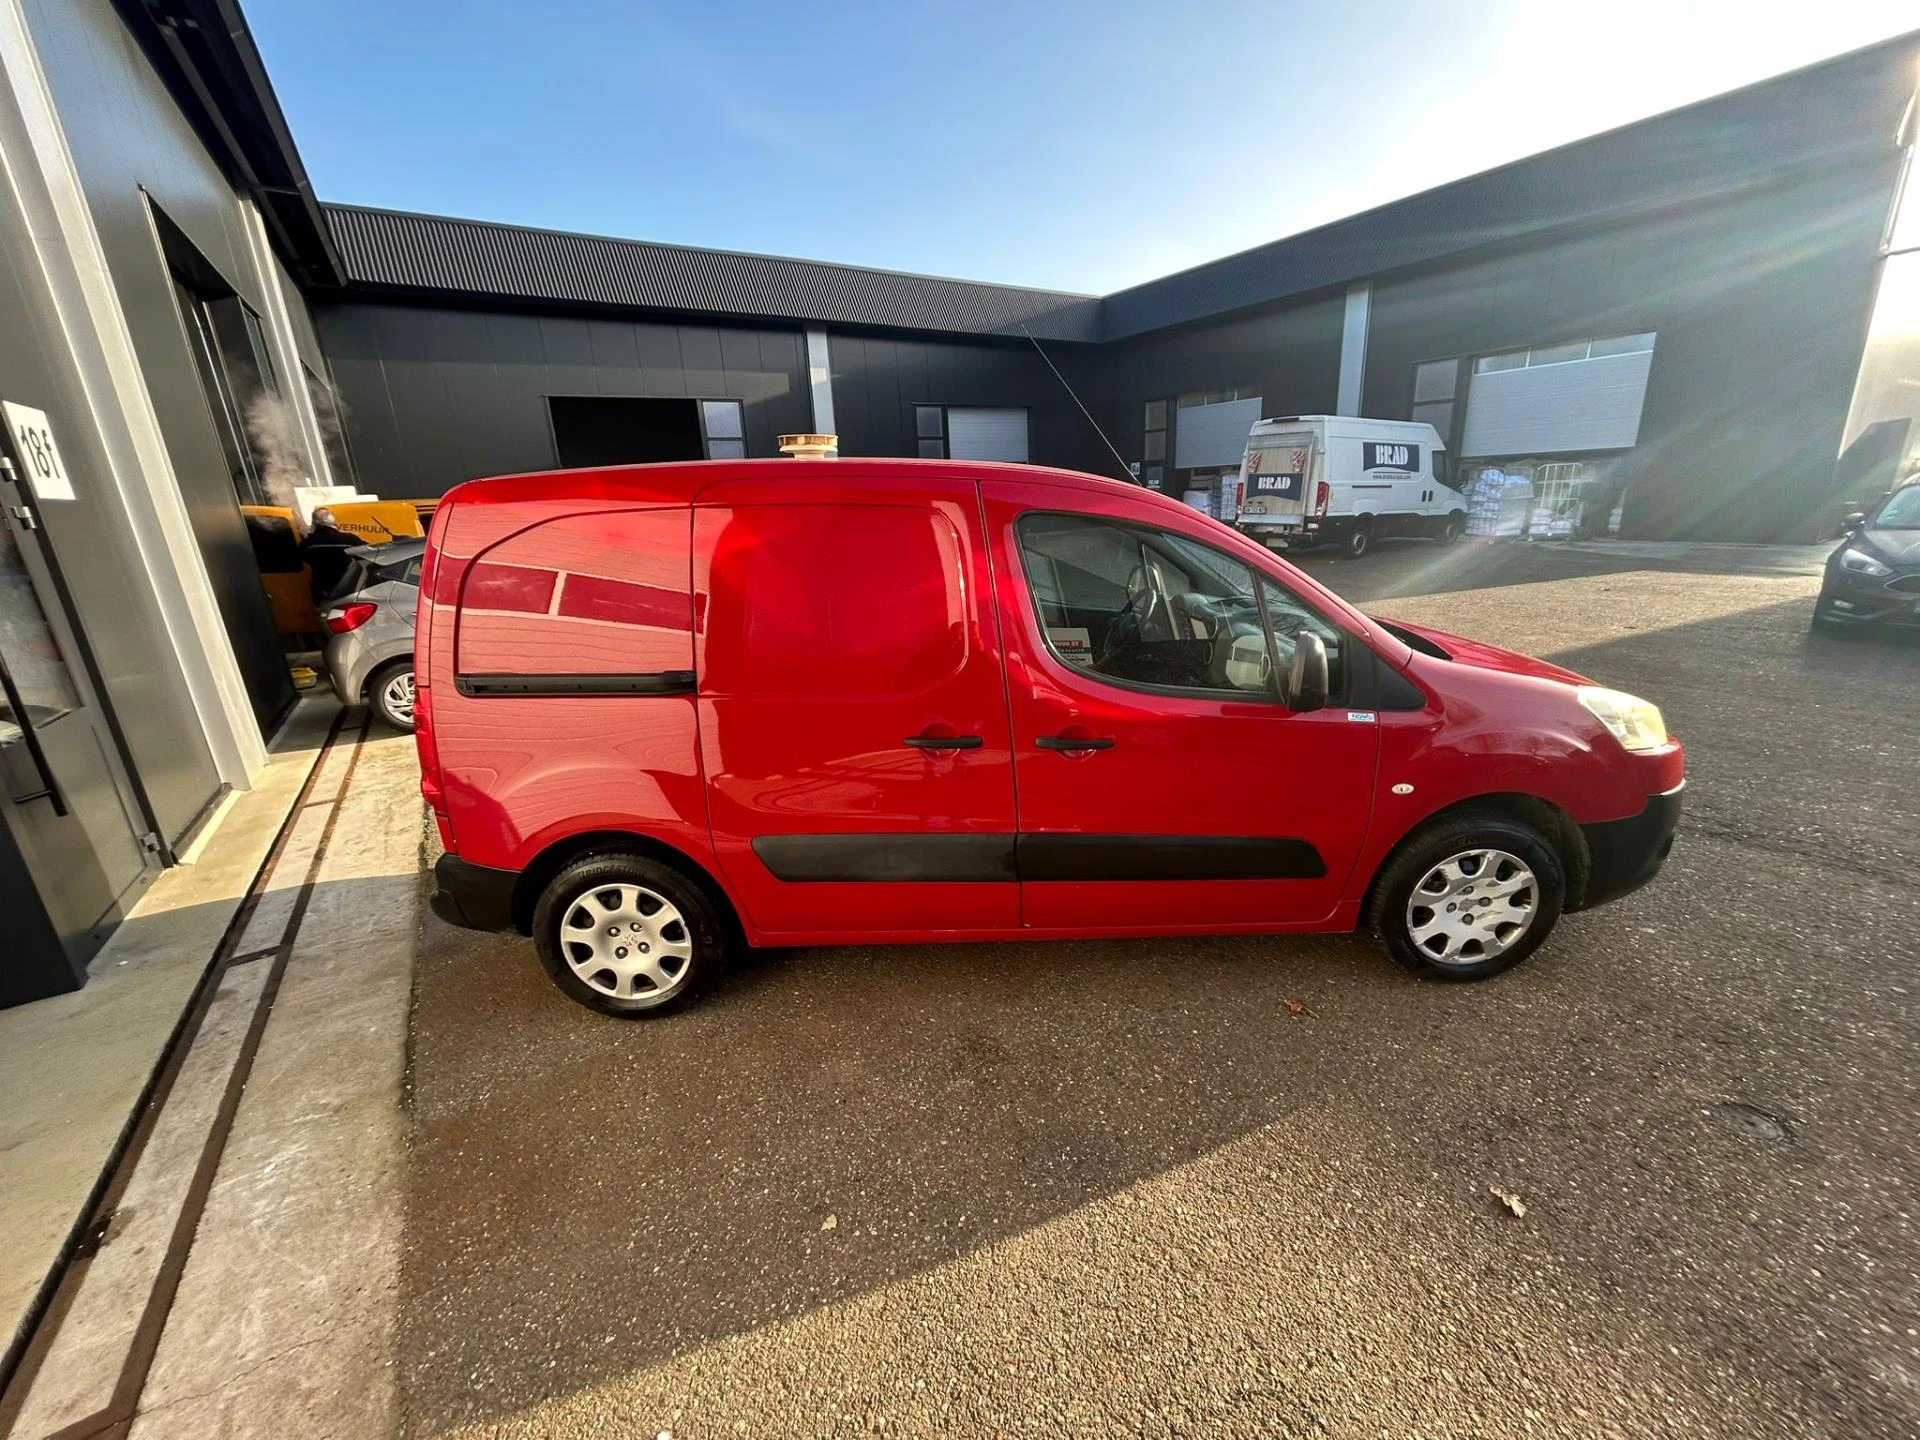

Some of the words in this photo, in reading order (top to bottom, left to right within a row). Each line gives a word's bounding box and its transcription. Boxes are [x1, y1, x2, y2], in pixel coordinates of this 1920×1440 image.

[20, 425, 60, 479] 18f
[1375, 444, 1409, 465] BRAD
[1258, 476, 1292, 489] BRAD
